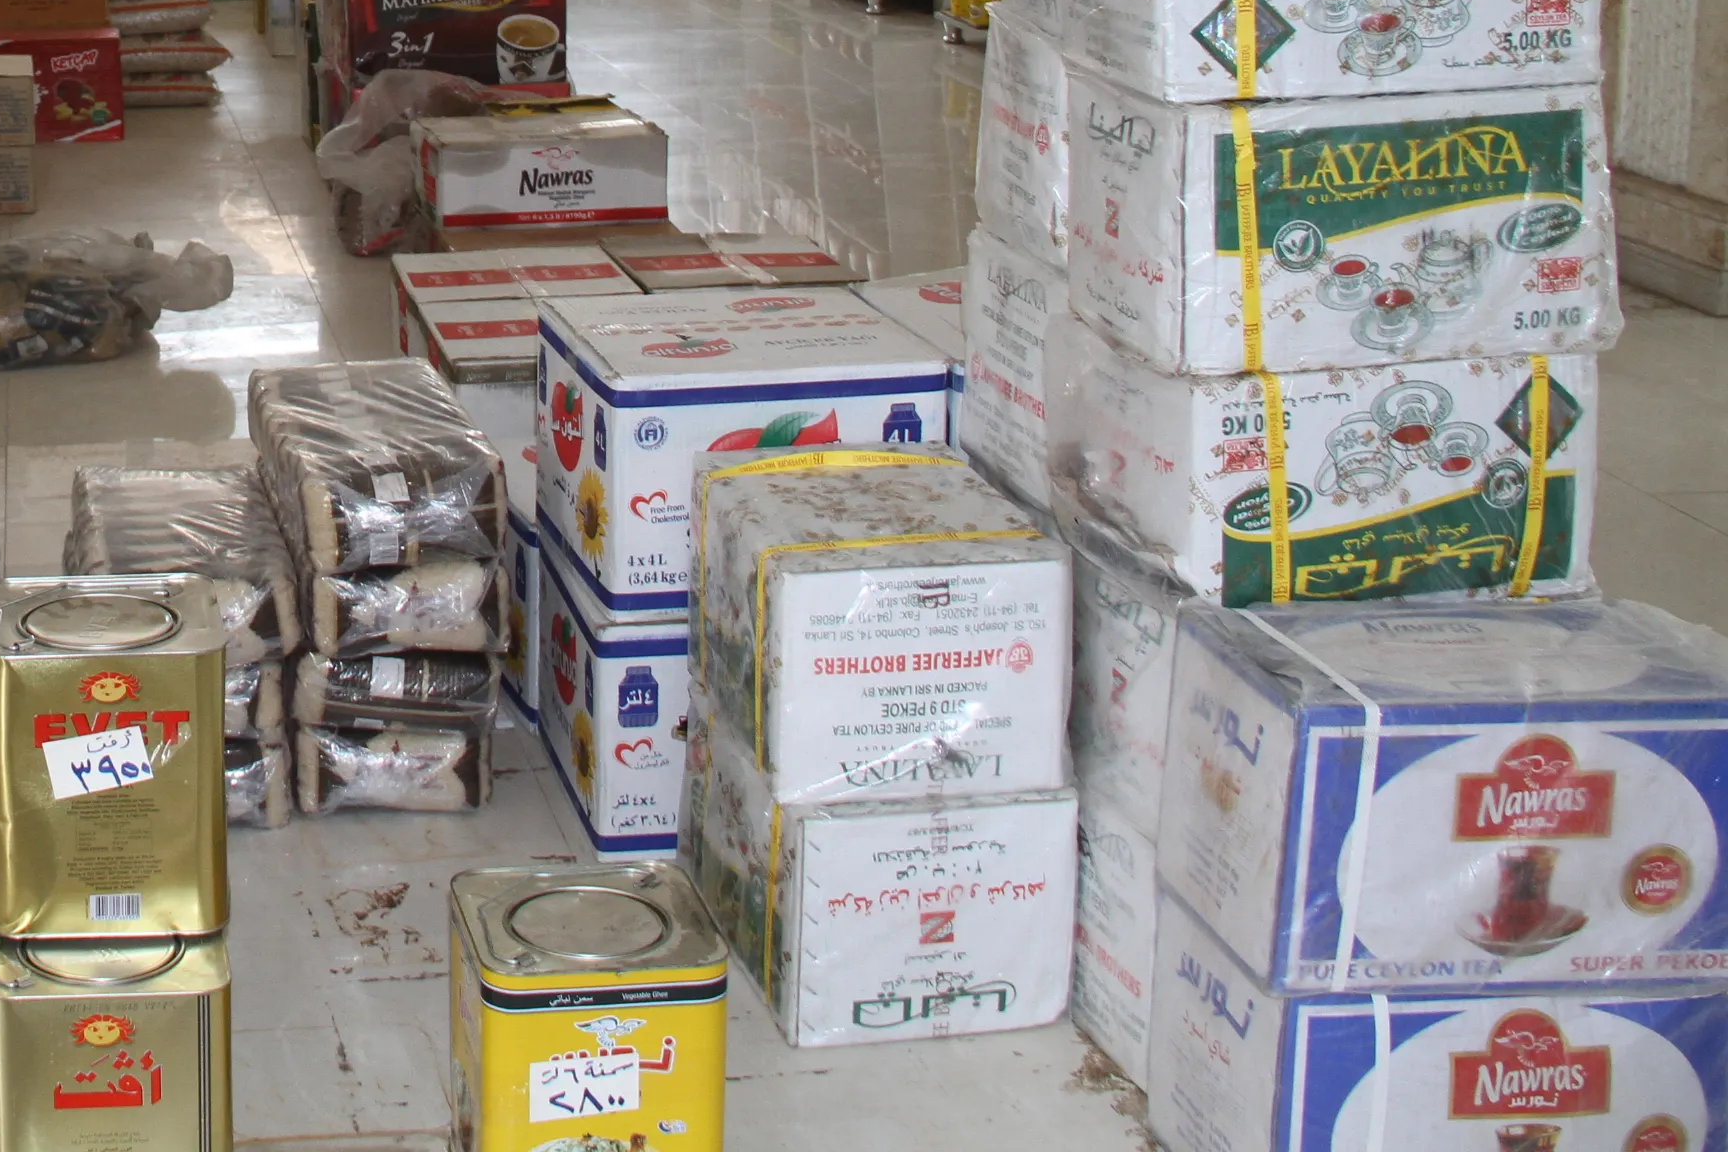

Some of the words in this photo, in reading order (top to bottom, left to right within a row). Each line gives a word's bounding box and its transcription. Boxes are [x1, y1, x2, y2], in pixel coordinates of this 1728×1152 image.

[1503, 31, 1540, 53] 5.00
[1545, 29, 1572, 48] KG
[1278, 125, 1529, 197] LAYALINA
[519, 168, 594, 196] Nawras
[1402, 185, 1437, 197] YOU
[1449, 180, 1507, 194] TRUST
[1513, 309, 1551, 330] 5.00
[1557, 306, 1581, 327] KG
[1221, 416, 1246, 435] KG
[650, 506, 666, 515] Free
[667, 505, 685, 513] From
[627, 555, 634, 566] 4
[647, 554, 656, 566] 4
[662, 569, 676, 583] kg
[840, 629, 854, 642] Sri
[875, 626, 920, 639] Colombo
[813, 655, 906, 675] BROTHERS
[912, 647, 1004, 672] JAFFERJEE
[861, 686, 877, 698] BY
[880, 684, 913, 697] LANKA
[915, 683, 932, 695] SRI
[935, 683, 944, 694] IN
[946, 680, 988, 694] PACKED
[619, 689, 642, 710] لتر
[645, 689, 653, 704] ٤
[881, 702, 926, 718] PEKOE
[929, 701, 938, 716] 9
[941, 699, 966, 716] STD
[832, 725, 851, 736] TEA
[854, 723, 893, 736] CEYLON
[895, 722, 922, 734] PURE
[923, 720, 936, 731] OF
[71, 755, 151, 792] ٣٩٥٠
[612, 794, 629, 809] لتر
[1476, 781, 1588, 828] Nawras
[1634, 877, 1679, 895] Nawras
[828, 895, 874, 917] شركة
[879, 889, 910, 912] زين
[917, 885, 964, 909] إخوان
[969, 884, 981, 898] و
[987, 873, 1046, 904] شركاهم
[1364, 959, 1455, 978] CEYLON
[1462, 959, 1502, 976] TEA
[1569, 955, 1644, 973] SUPER
[1657, 953, 1728, 970] PEKOE
[573, 995, 593, 1004] سمن
[622, 992, 651, 1000] Vegetable
[652, 990, 668, 999] Ghee
[1474, 1061, 1585, 1107] Nawras
[549, 1087, 625, 1113] ٢٨٠٠
[1508, 1093, 1559, 1110] نورس
